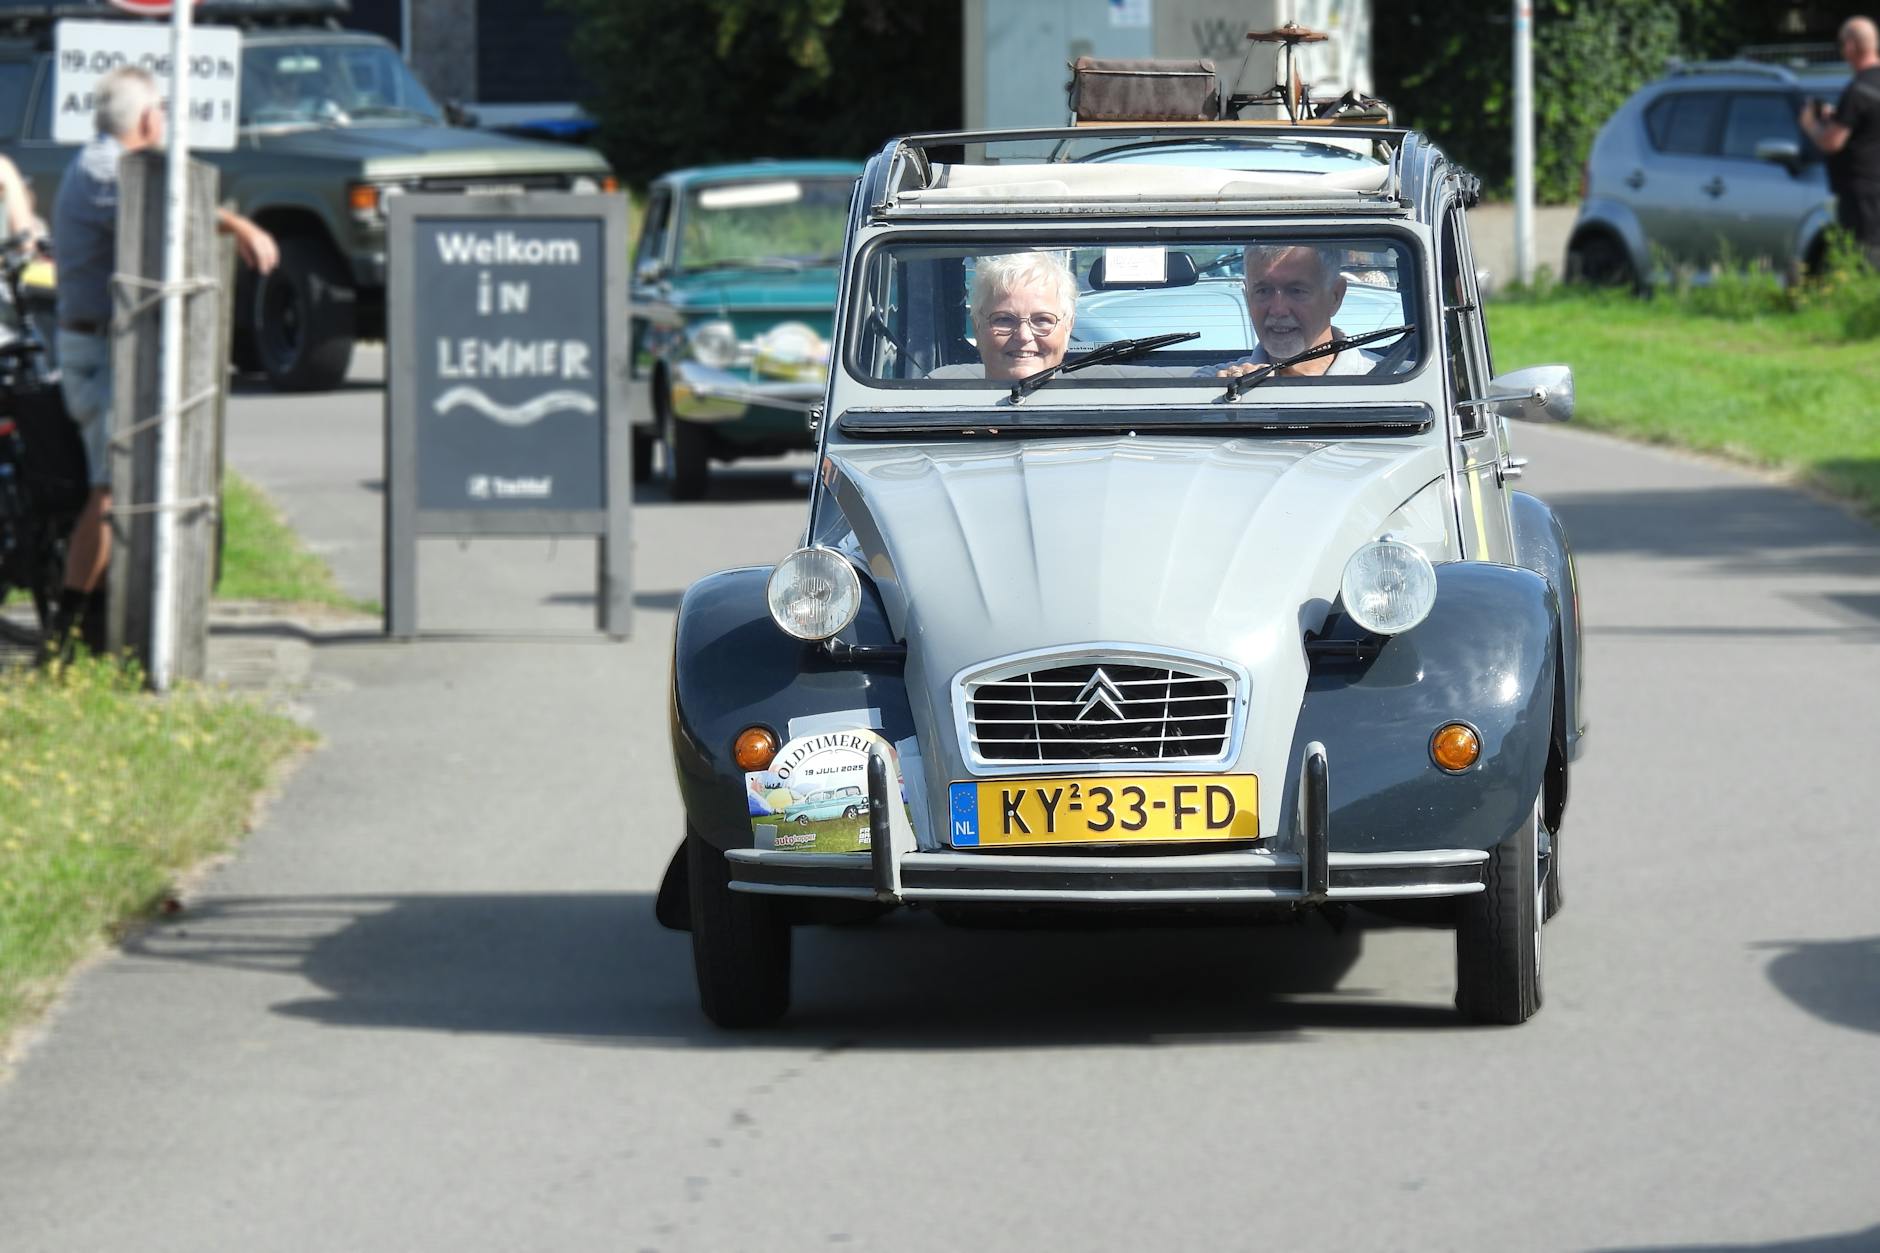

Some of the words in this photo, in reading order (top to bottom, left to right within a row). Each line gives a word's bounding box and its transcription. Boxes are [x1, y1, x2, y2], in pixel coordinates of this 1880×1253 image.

[436, 231, 580, 265] Welkom
[437, 338, 591, 379] LEMMER
[816, 767, 839, 775] JULI
[841, 764, 864, 772] 2025
[955, 821, 975, 836] NL
